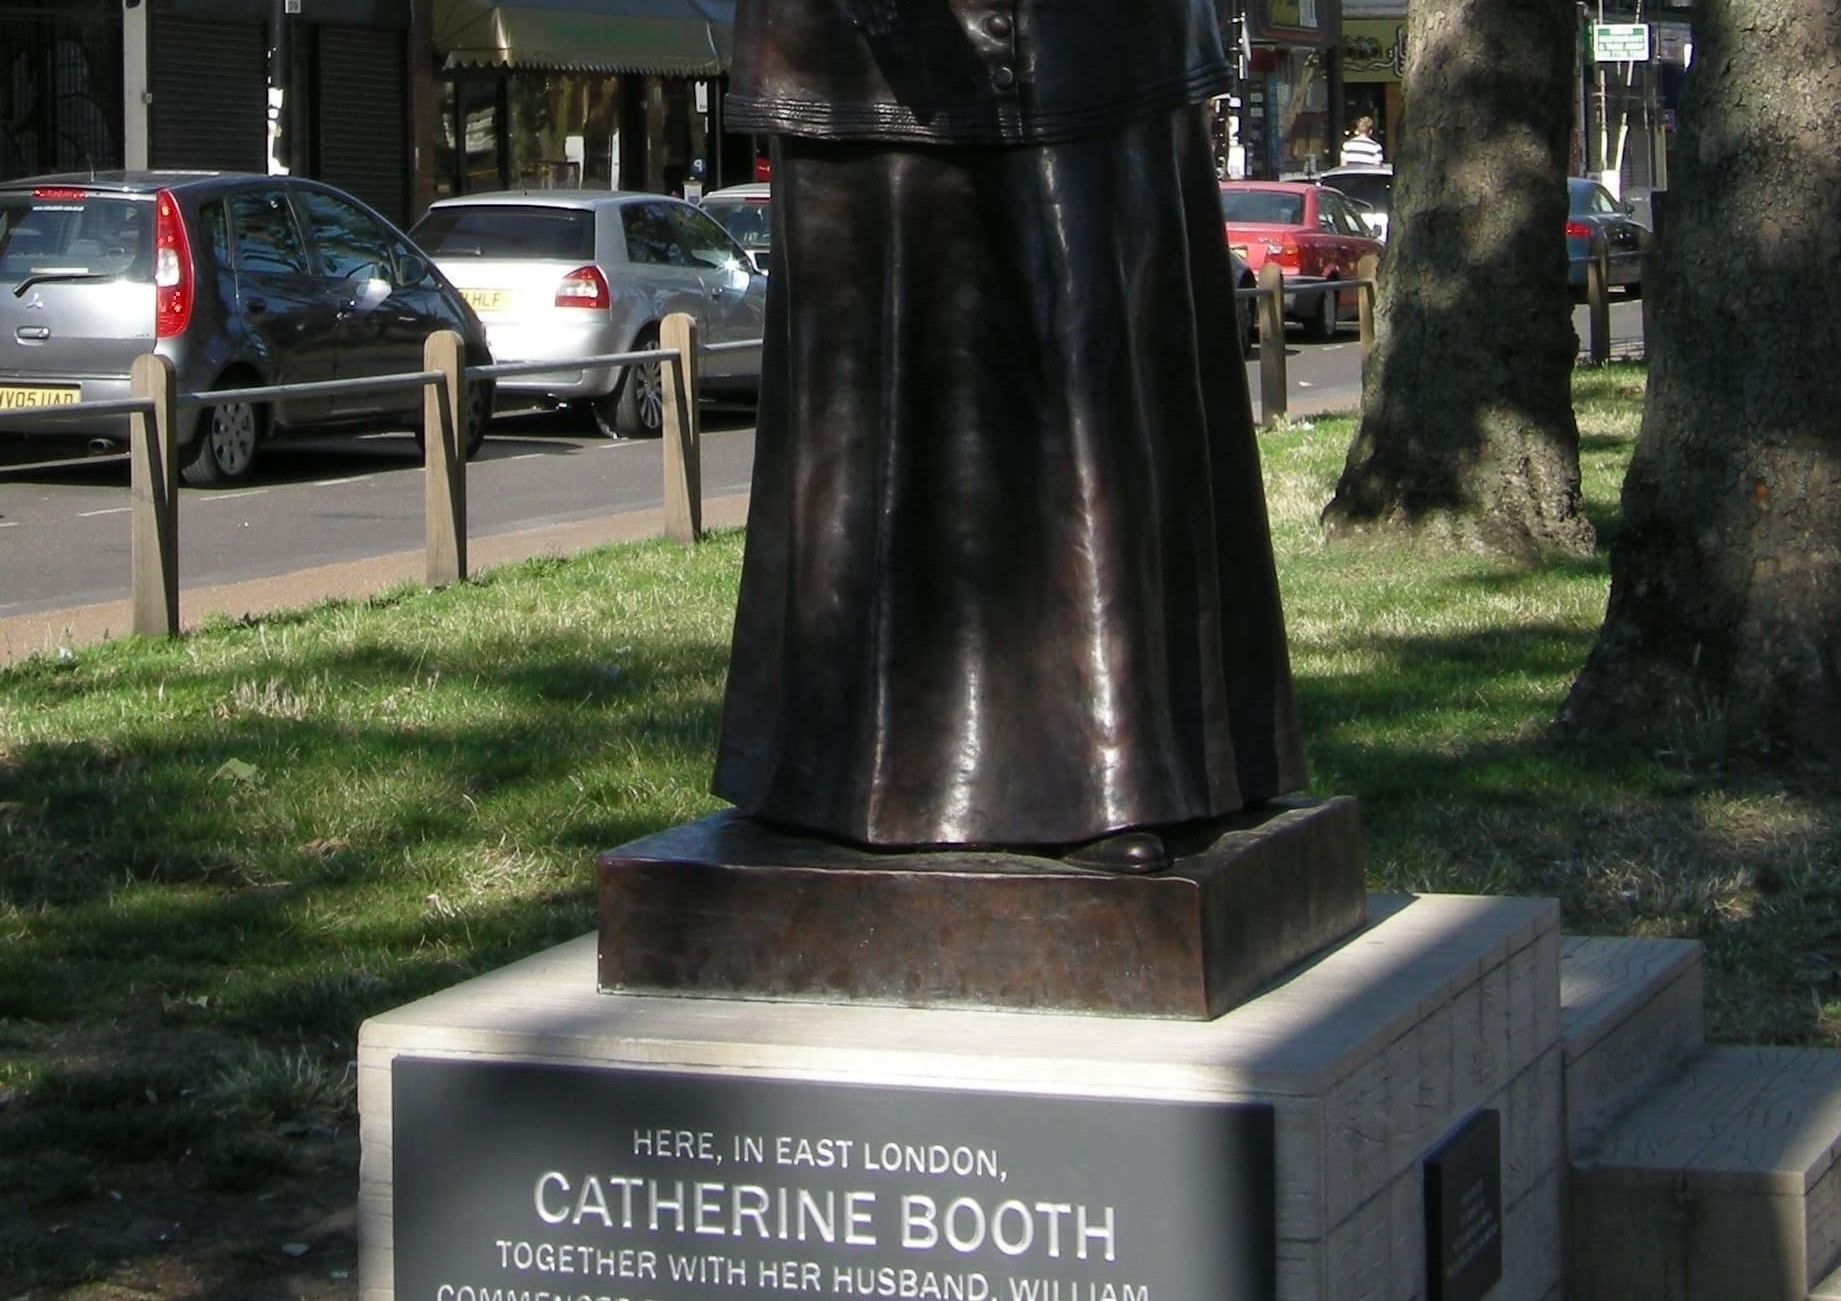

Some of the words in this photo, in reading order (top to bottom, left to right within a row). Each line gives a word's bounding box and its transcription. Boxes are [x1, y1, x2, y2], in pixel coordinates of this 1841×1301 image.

[472, 292, 503, 307] HLF
[633, 1129, 722, 1165] HERE,
[735, 1135, 763, 1164] IN
[776, 1137, 853, 1169] EAST
[864, 1142, 1007, 1182] LONDON,
[534, 1171, 877, 1245] CATHERINE
[902, 1194, 1116, 1261] BOOTH
[496, 1241, 657, 1279] TOGETHER
[668, 1254, 747, 1286] WITH
[758, 1260, 821, 1291] HER
[1009, 1277, 1149, 1301] WILLIAM
